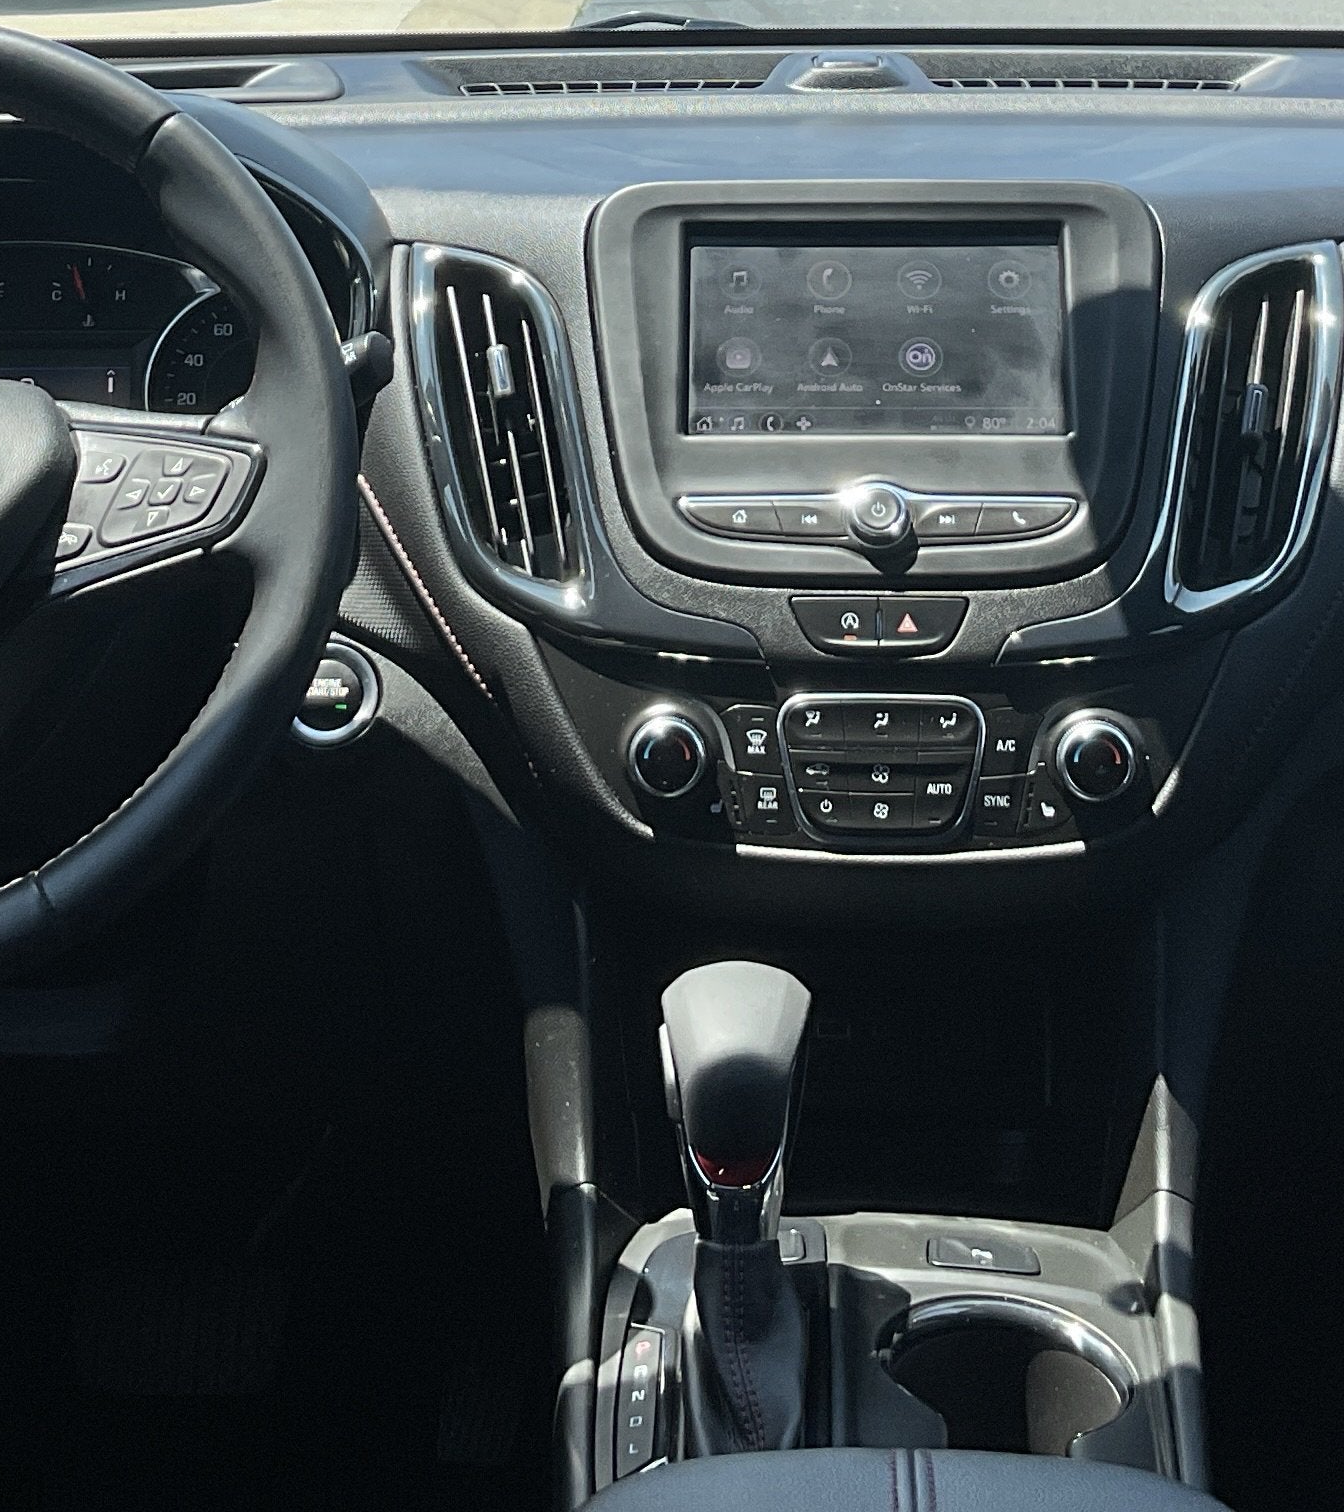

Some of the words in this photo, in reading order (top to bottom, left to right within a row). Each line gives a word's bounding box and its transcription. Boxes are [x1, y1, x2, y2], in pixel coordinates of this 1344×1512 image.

[51, 289, 63, 301] C
[115, 289, 126, 301] H
[724, 305, 754, 314] Audio
[813, 305, 846, 315] Phone
[906, 304, 934, 314] Wi-Fi
[990, 304, 1031, 316] Settings
[213, 323, 233, 337] 60
[183, 354, 204, 367] 40
[704, 382, 733, 392] Apple
[735, 383, 773, 394] CarPlay
[797, 382, 837, 392] Android
[839, 383, 863, 392] Auto
[882, 382, 917, 392] OnStar
[920, 382, 962, 392] Services
[177, 392, 197, 406] 20
[747, 745, 767, 755] MAX
[995, 739, 1016, 754] A/C
[925, 781, 953, 796] AUTO
[757, 800, 779, 810] REAR
[983, 794, 1011, 808] SYNC
[635, 1340, 651, 1358] P
[631, 1389, 645, 1402] N
[629, 1415, 643, 1427] D
[628, 1443, 639, 1455] L
